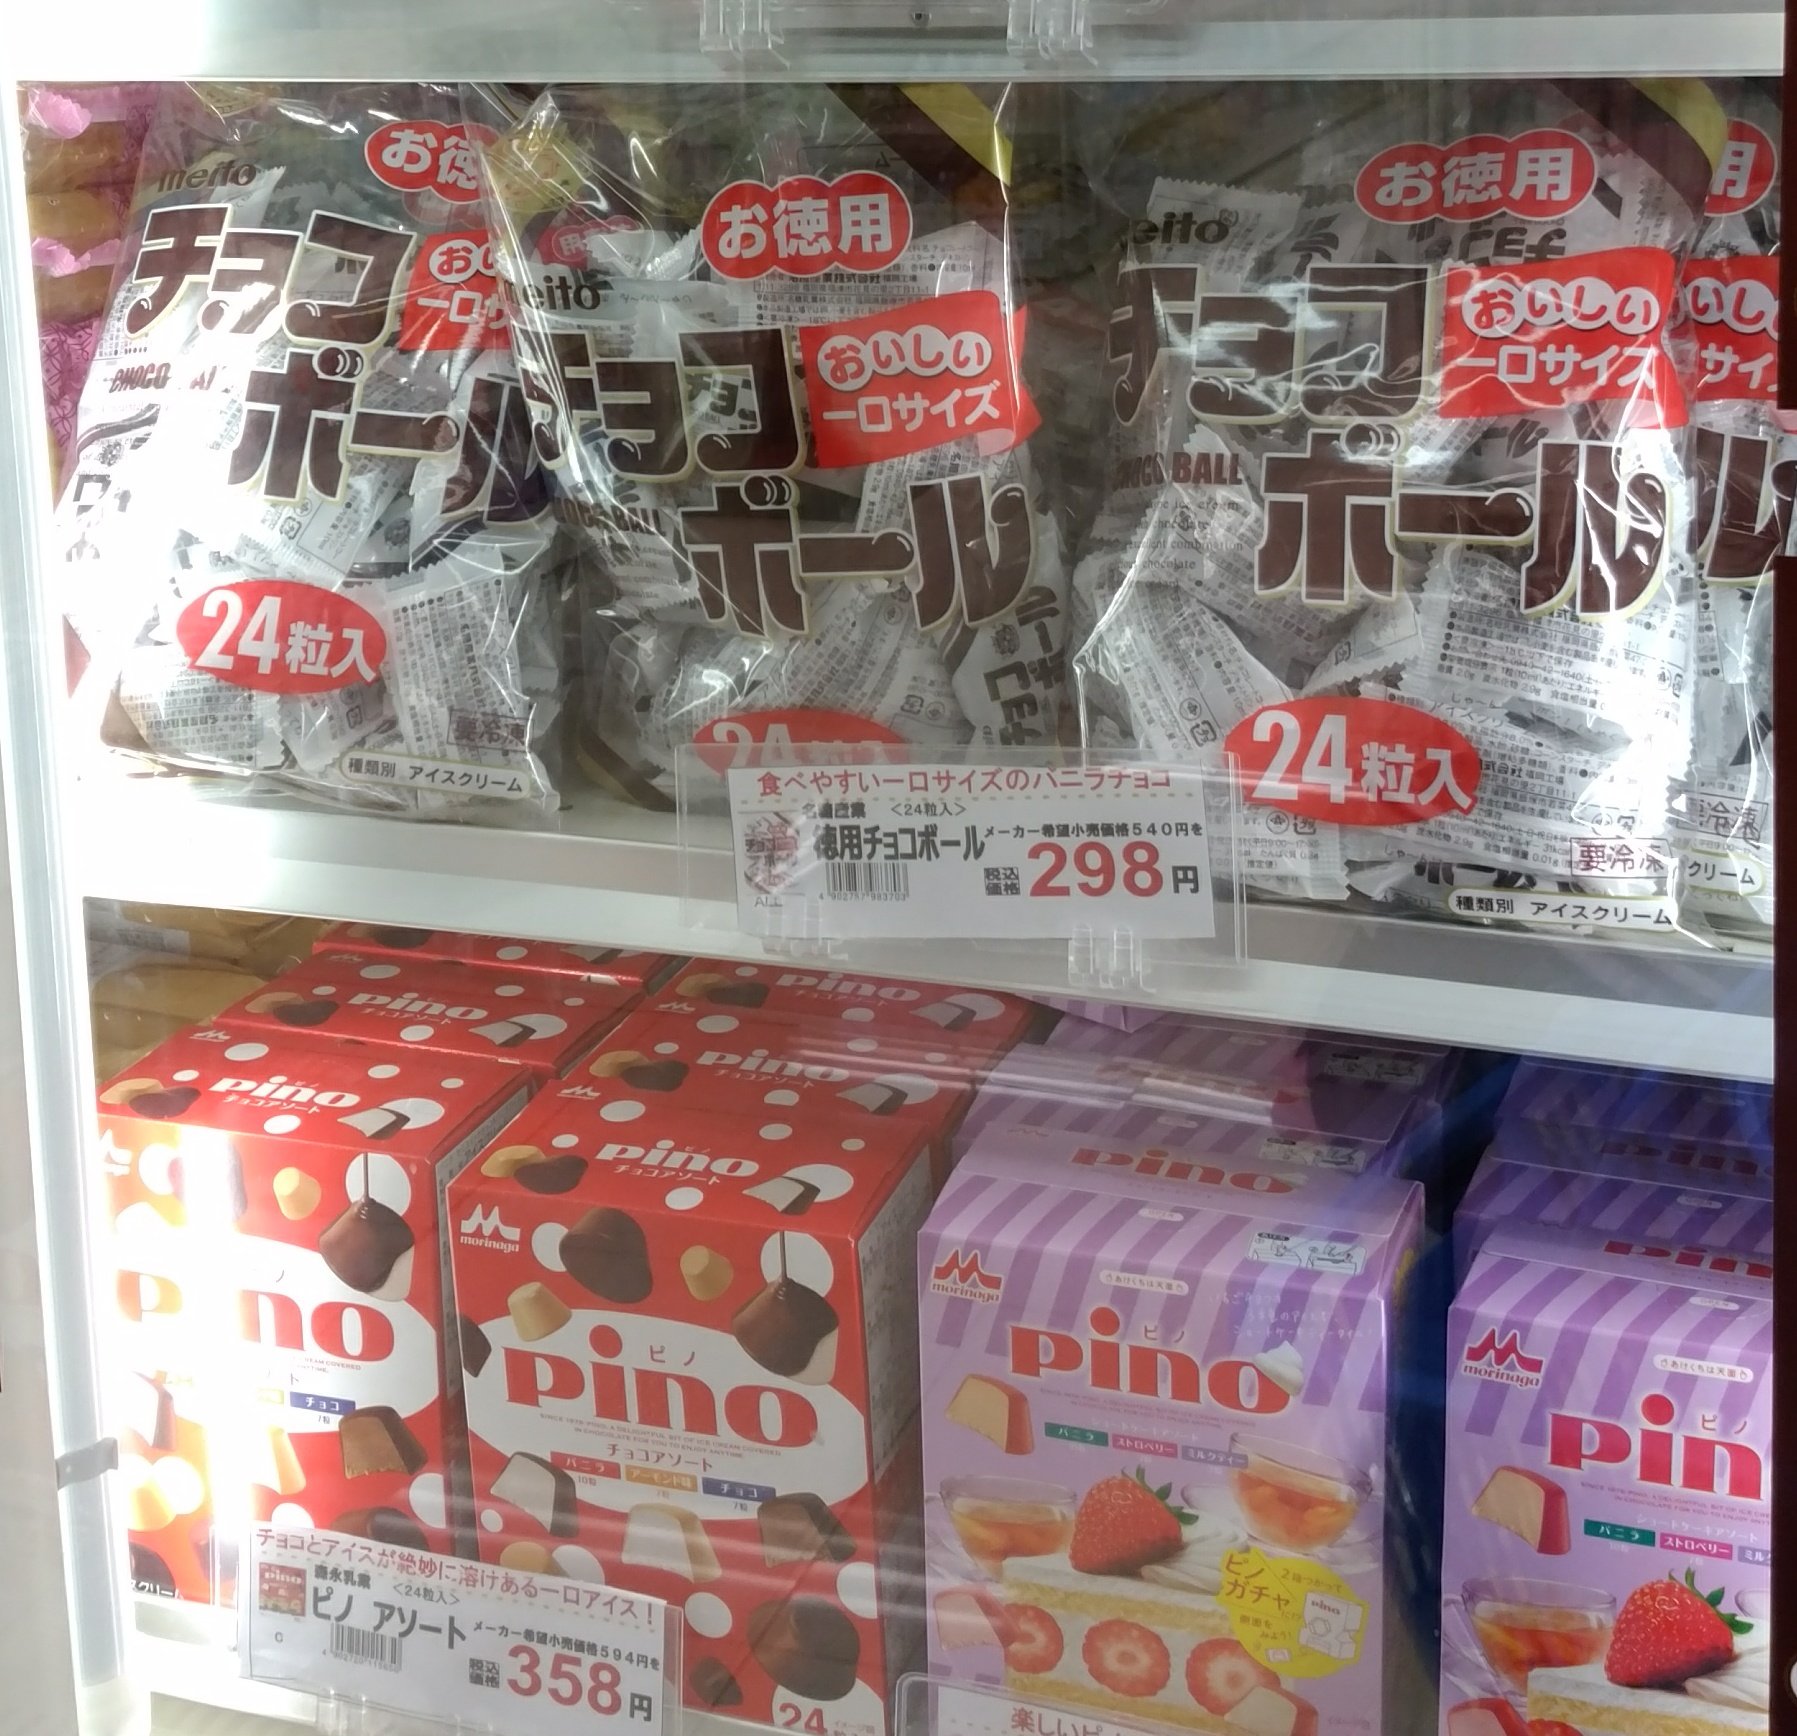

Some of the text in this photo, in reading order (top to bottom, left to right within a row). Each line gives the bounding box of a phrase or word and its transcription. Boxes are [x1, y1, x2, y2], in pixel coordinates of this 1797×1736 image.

[157, 160, 257, 192] meito
[1377, 147, 1573, 206] お徳用
[717, 193, 893, 260] お徳用
[1131, 211, 1229, 244] eito
[125, 203, 417, 347] チョコ
[1470, 283, 1655, 331] おいしい
[824, 331, 985, 386] おいしい
[1108, 263, 1432, 424] チョコ
[1457, 343, 1657, 392] 一口サイズ
[511, 325, 806, 482] チョコ
[822, 379, 1002, 434] 一口サイズ
[228, 346, 552, 528] ボール
[1172, 452, 1242, 484] BALL
[1255, 423, 1671, 620] ボール
[679, 472, 1038, 638] ボール
[193, 588, 377, 685] 24粒入
[350, 757, 522, 793] 種類別 アイスクリーム
[1250, 709, 1476, 816] 24粒入
[757, 768, 1171, 797] 食べやすい一口サイズのバニラチョコ
[813, 823, 986, 862] 徳用チョコボール
[1027, 840, 1163, 897] 298
[1172, 865, 1200, 894] 円
[1688, 860, 1756, 886] クリーム
[1455, 894, 1673, 926] 種類別 アイスクリーム
[776, 973, 922, 1001] pino
[348, 993, 489, 1020] pino
[696, 1049, 850, 1083] pino
[208, 1075, 361, 1108] pino
[223, 1093, 321, 1114] チョコアソート
[595, 1139, 760, 1178] pino
[1071, 1148, 1296, 1194] pino
[614, 1164, 721, 1186] チョコアソート
[460, 1235, 520, 1254] morinaga
[932, 1283, 1000, 1304] morinaga
[1144, 1324, 1185, 1343] ピノ
[650, 1344, 696, 1367] ピノ
[1010, 1306, 1291, 1415] pino
[1669, 1358, 1737, 1378] あけくちは天面
[502, 1324, 819, 1449] pino
[1463, 1365, 1541, 1388] morinaga
[306, 1396, 340, 1412] チョコ
[1058, 1427, 1095, 1442] バニラ
[1702, 1414, 1748, 1435] ピノ
[607, 1443, 712, 1473] チョコアソート
[1118, 1438, 1175, 1454] ストロベリー
[566, 1457, 606, 1473] バニラ
[720, 1483, 758, 1499] チョコ
[1599, 1524, 1640, 1541] バニラ
[1664, 1536, 1731, 1555] ストロベリー
[1225, 1553, 1265, 1581] ピノ
[1226, 1579, 1290, 1611] ガチャ
[313, 1585, 467, 1650] ピノ アソート
[507, 1643, 653, 1722] 358 円
